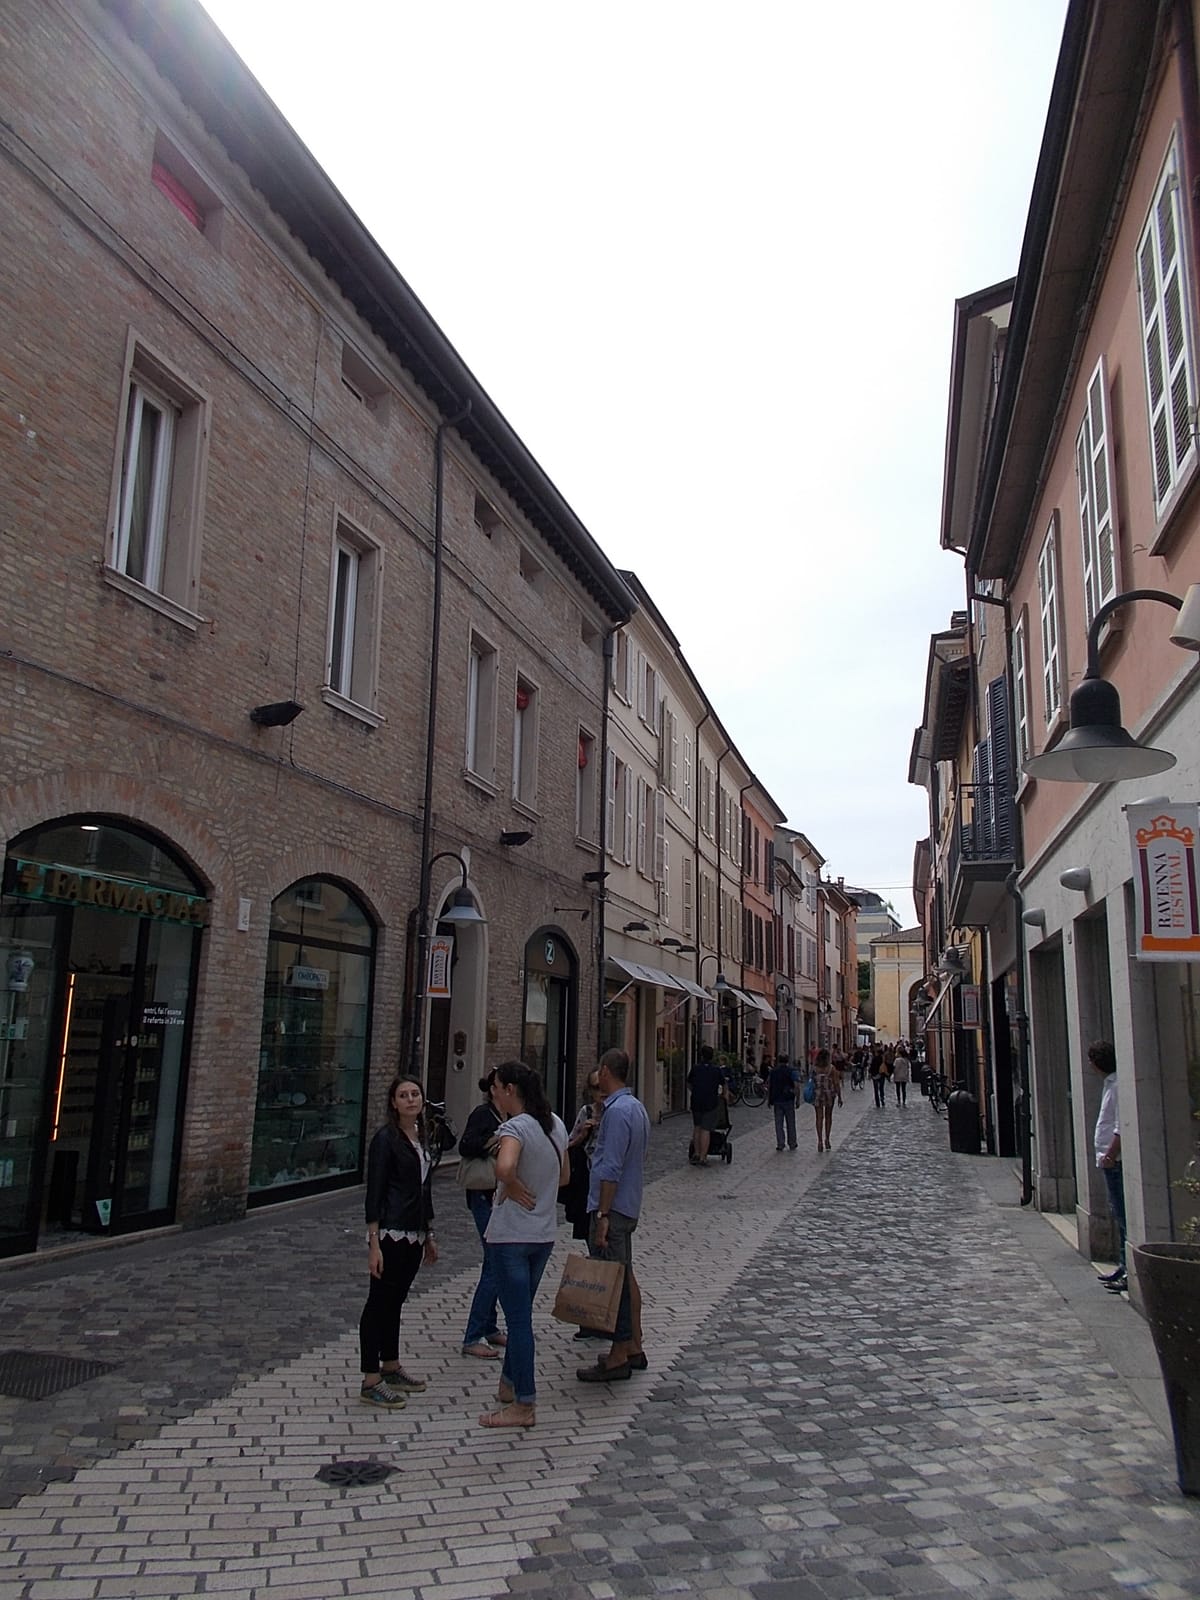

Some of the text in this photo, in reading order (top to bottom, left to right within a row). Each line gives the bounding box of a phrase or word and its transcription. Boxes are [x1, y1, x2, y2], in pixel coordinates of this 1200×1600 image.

[46, 869, 192, 921] FARMACIA
[1153, 852, 1172, 928] RAVENNA
[1167, 850, 1185, 928] FESTIVAL
